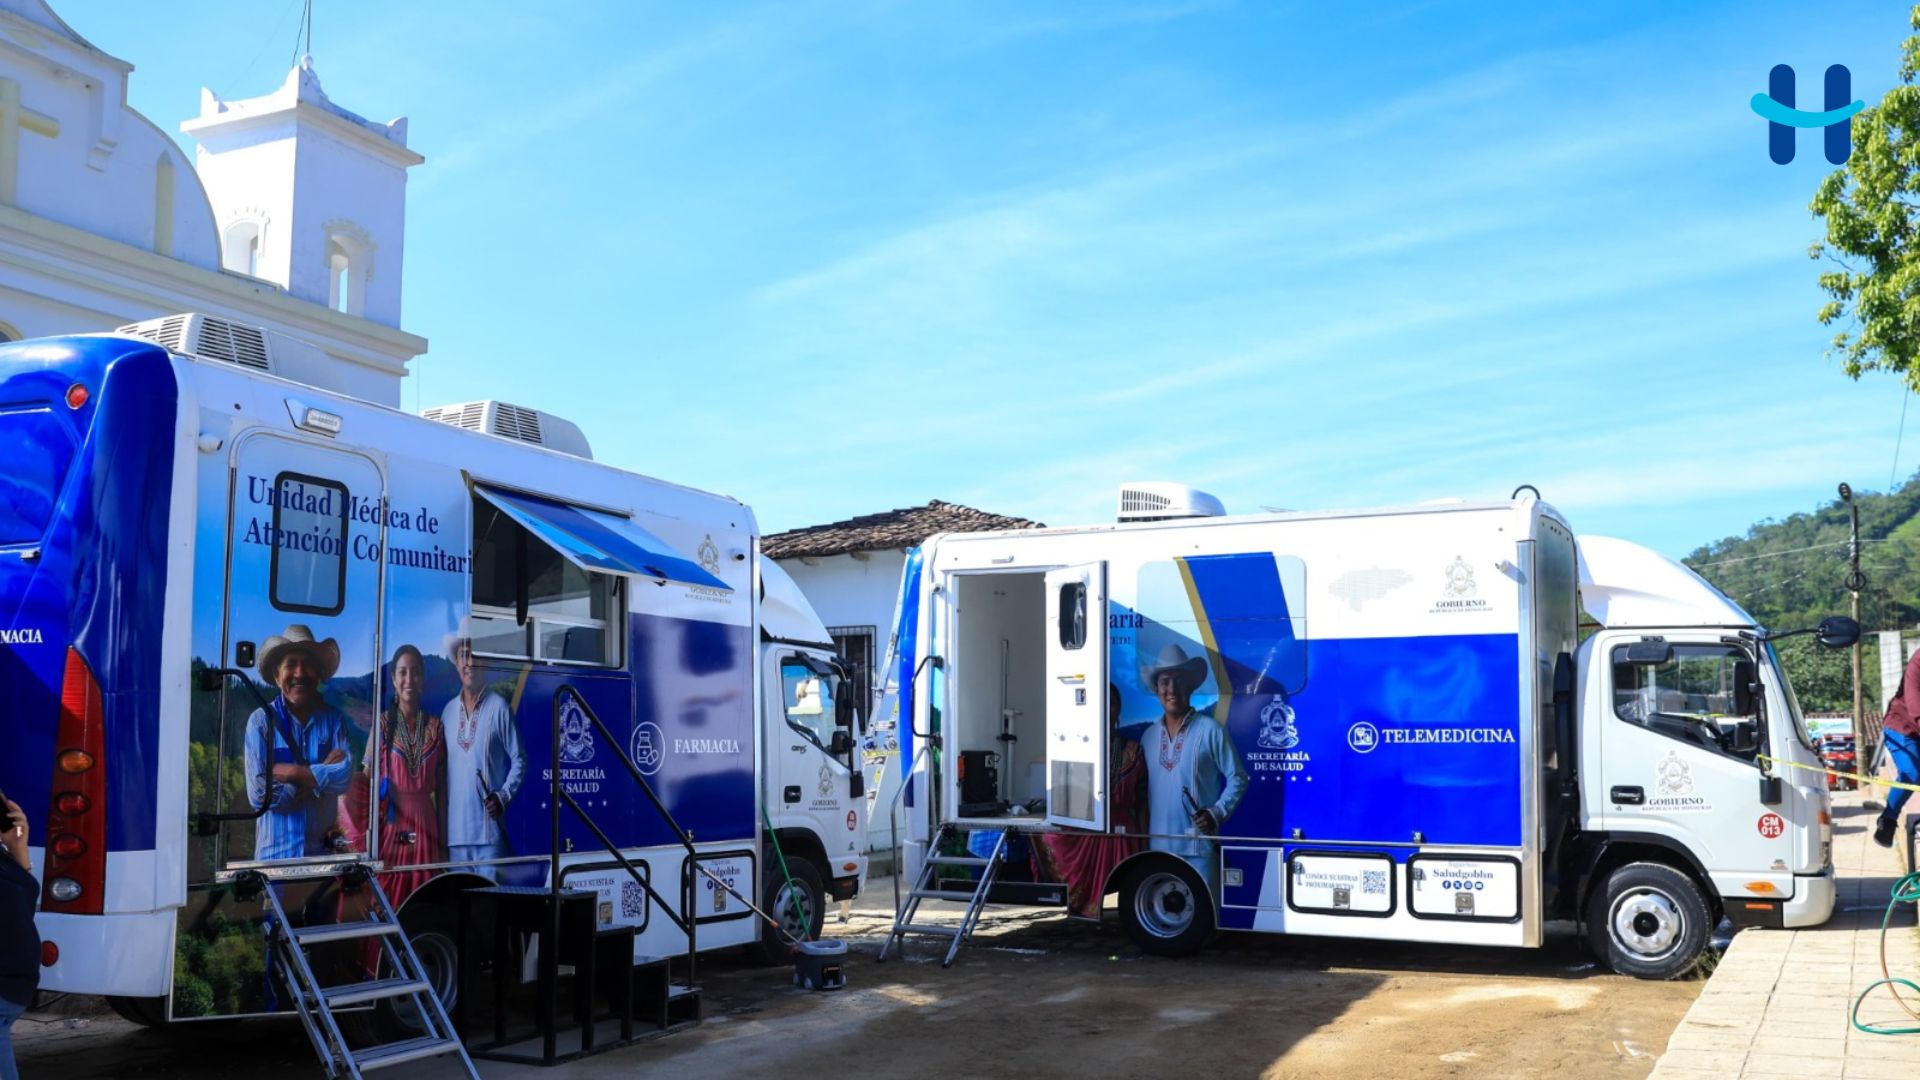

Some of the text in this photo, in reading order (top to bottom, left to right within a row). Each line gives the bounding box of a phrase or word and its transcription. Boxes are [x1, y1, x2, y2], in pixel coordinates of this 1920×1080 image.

[247, 476, 439, 534] Unidad Médica de
[243, 517, 342, 556] Atención
[1436, 600, 1486, 608] GOBIERNO
[1110, 607, 1144, 628] aria
[1382, 729, 1515, 743] TELEMEDICINA
[674, 739, 740, 753] FARMACIA
[1247, 752, 1310, 761] SECRETARÍA
[1254, 762, 1304, 771] DE SALUD
[566, 782, 600, 793] SALUD
[1649, 797, 1704, 806] GOBIERNO
[1763, 817, 1779, 826] CM
[1761, 826, 1781, 835] 013
[1433, 868, 1493, 879] Saludgobhn
